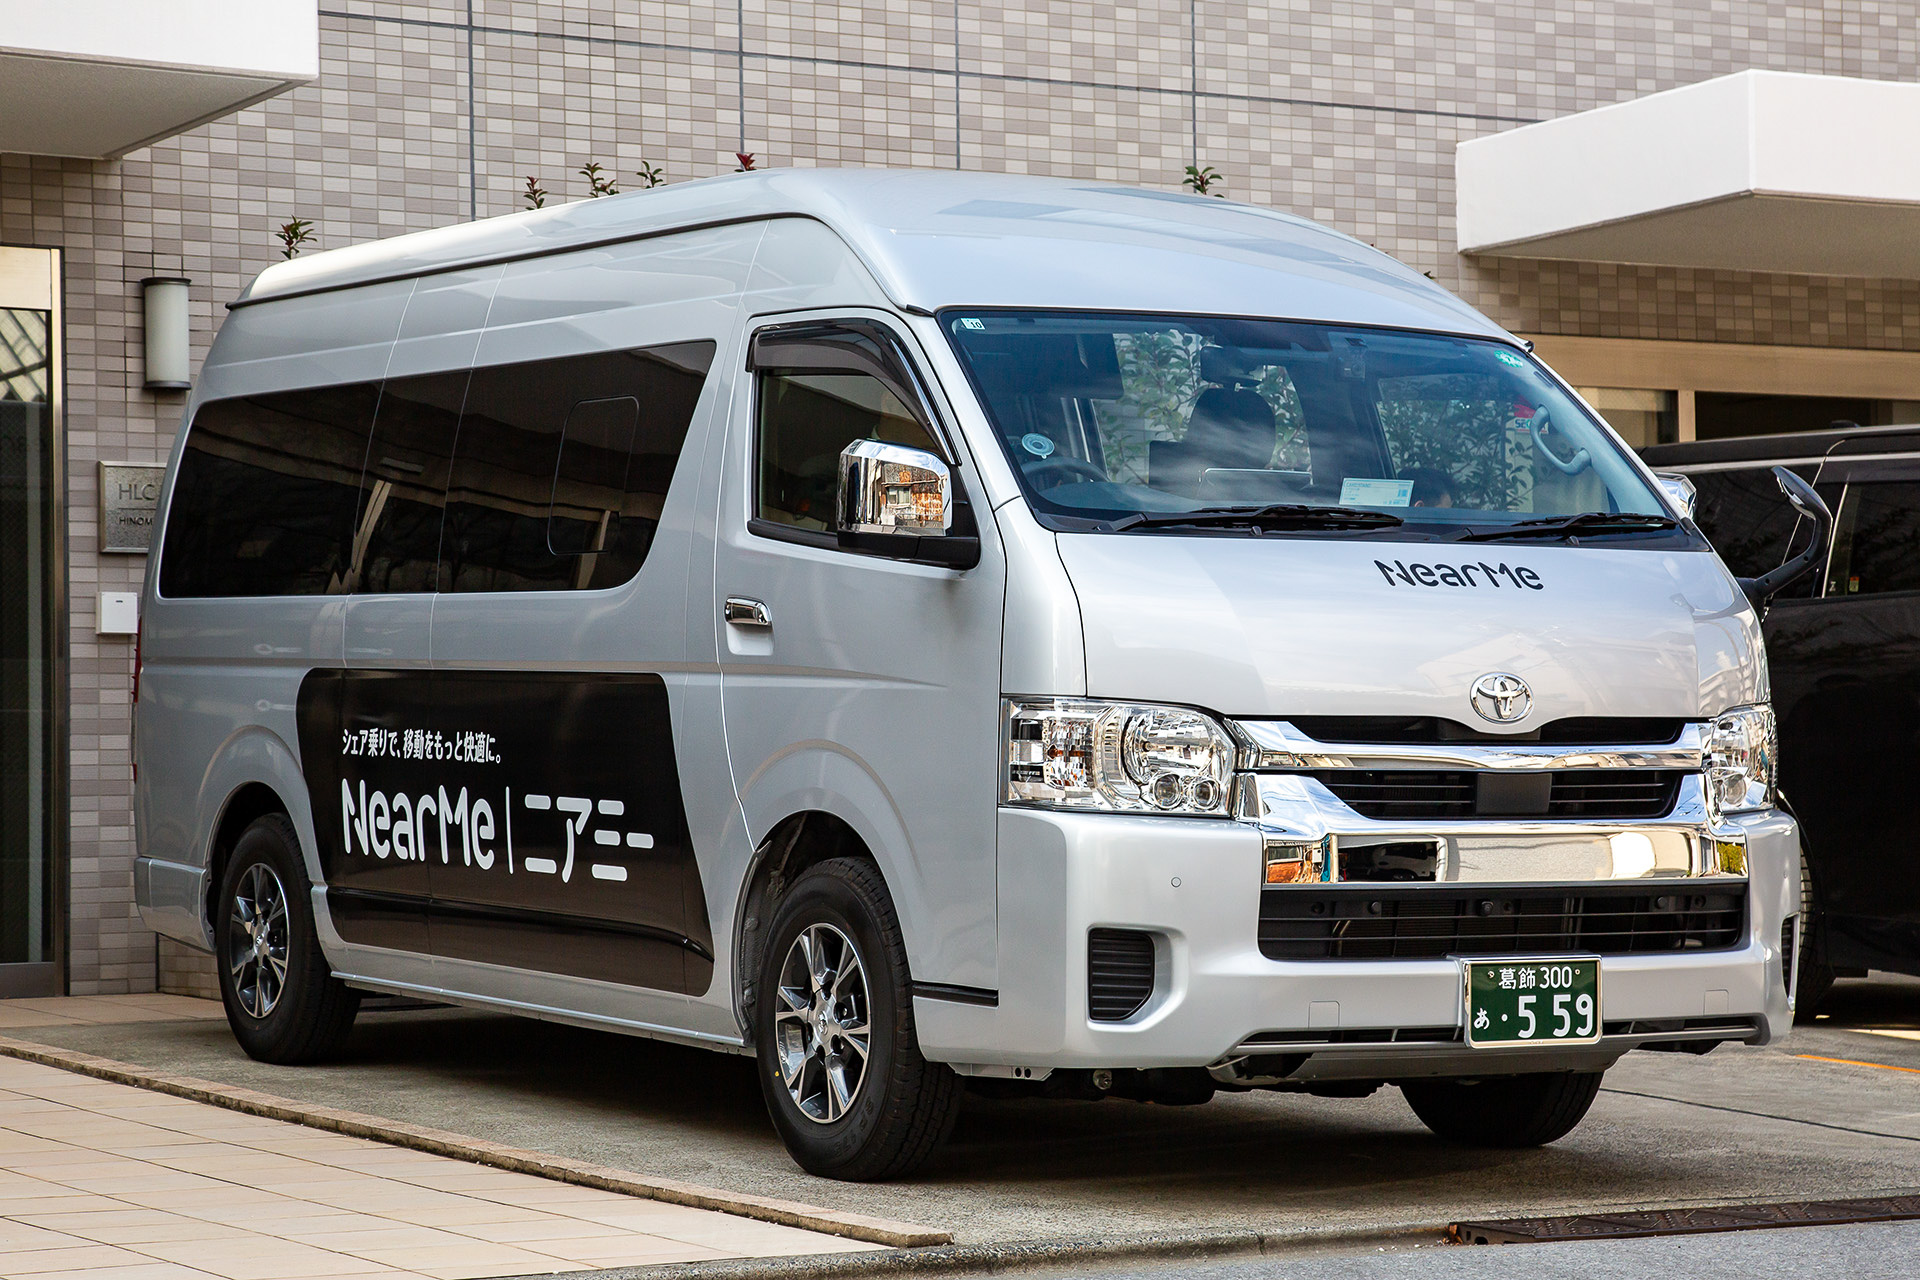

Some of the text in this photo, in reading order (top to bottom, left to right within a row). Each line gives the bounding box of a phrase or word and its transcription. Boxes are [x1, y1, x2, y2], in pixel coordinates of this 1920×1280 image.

[119, 484, 155, 500] HLC
[1374, 560, 1544, 590] NearMe
[342, 727, 501, 764] シェア乗りで、移動をもっと快適に。
[342, 778, 495, 870] NearMe
[1498, 966, 1573, 990] 葛飾 300
[1473, 1008, 1490, 1030] あ
